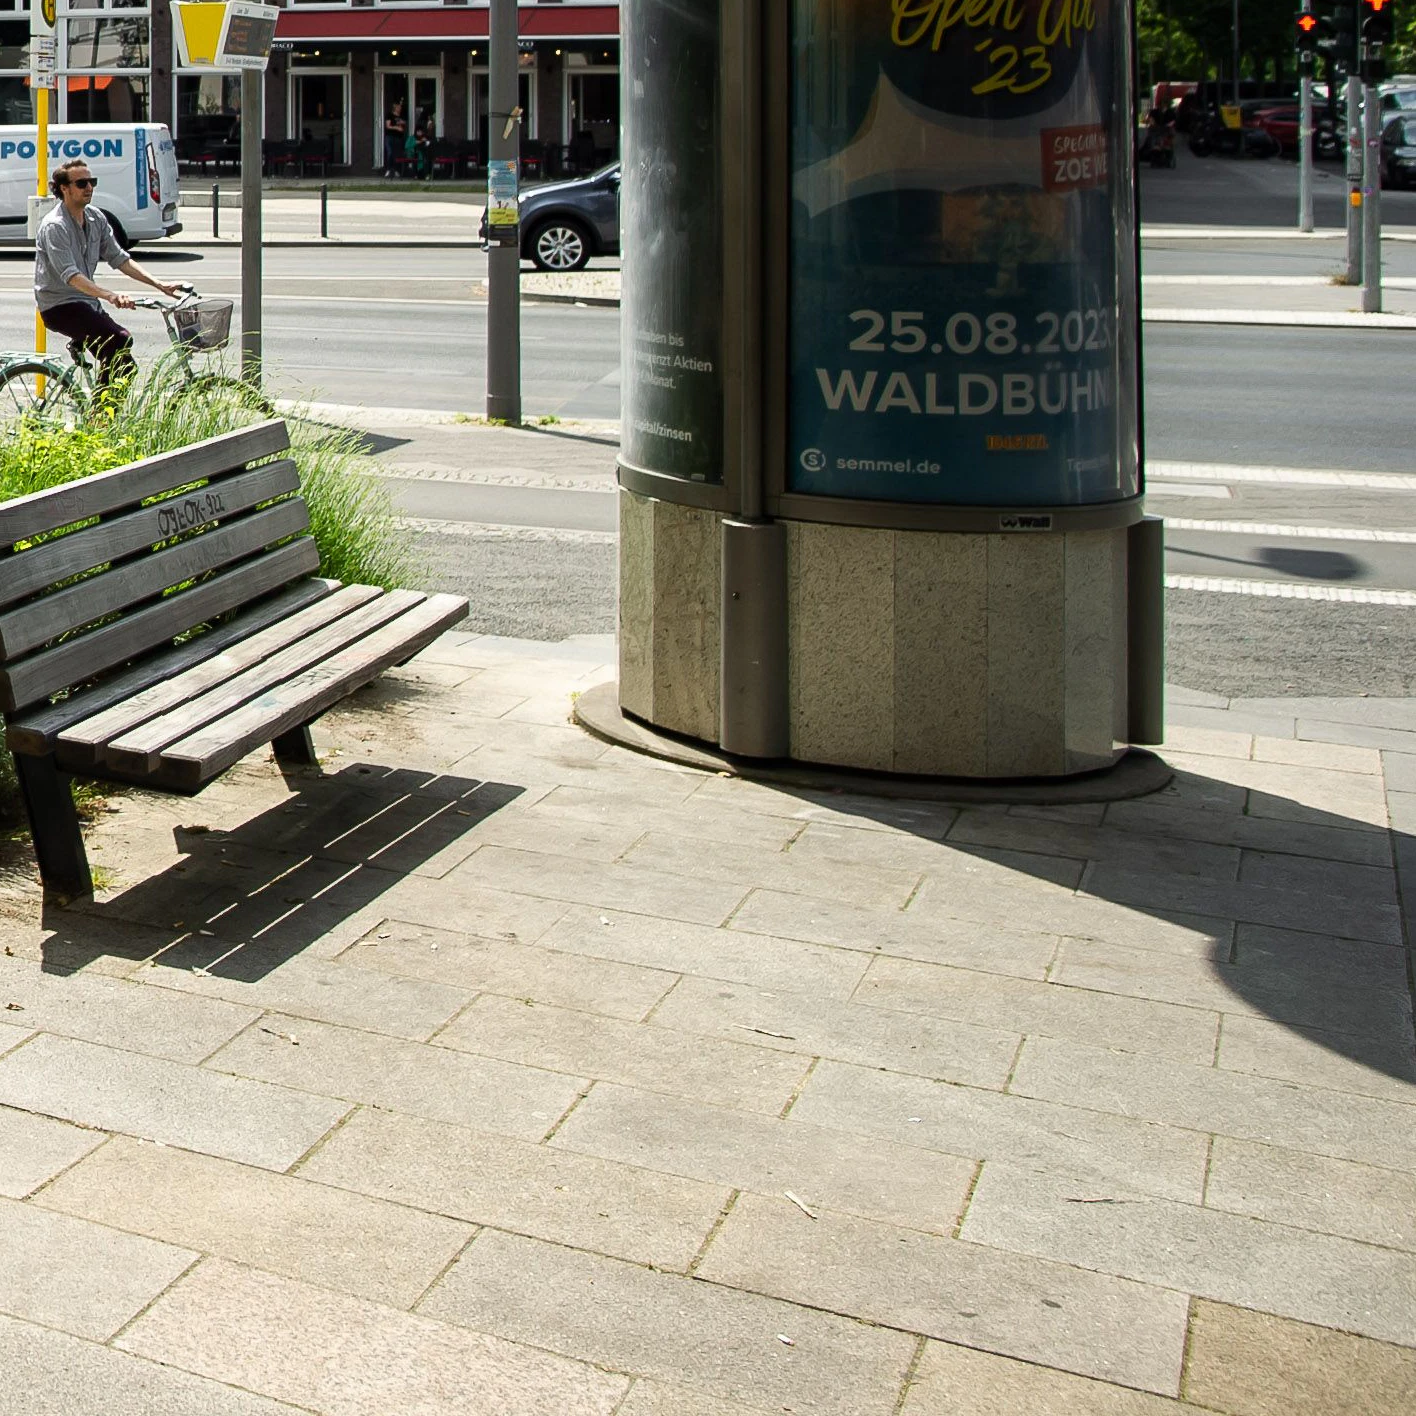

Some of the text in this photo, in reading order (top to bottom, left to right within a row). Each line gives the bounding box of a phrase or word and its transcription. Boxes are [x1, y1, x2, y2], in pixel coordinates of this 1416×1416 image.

[0, 138, 123, 160] POYGON
[1052, 156, 1092, 184] ZOE
[673, 355, 713, 373] Aktien
[836, 456, 942, 475] semmel.de
